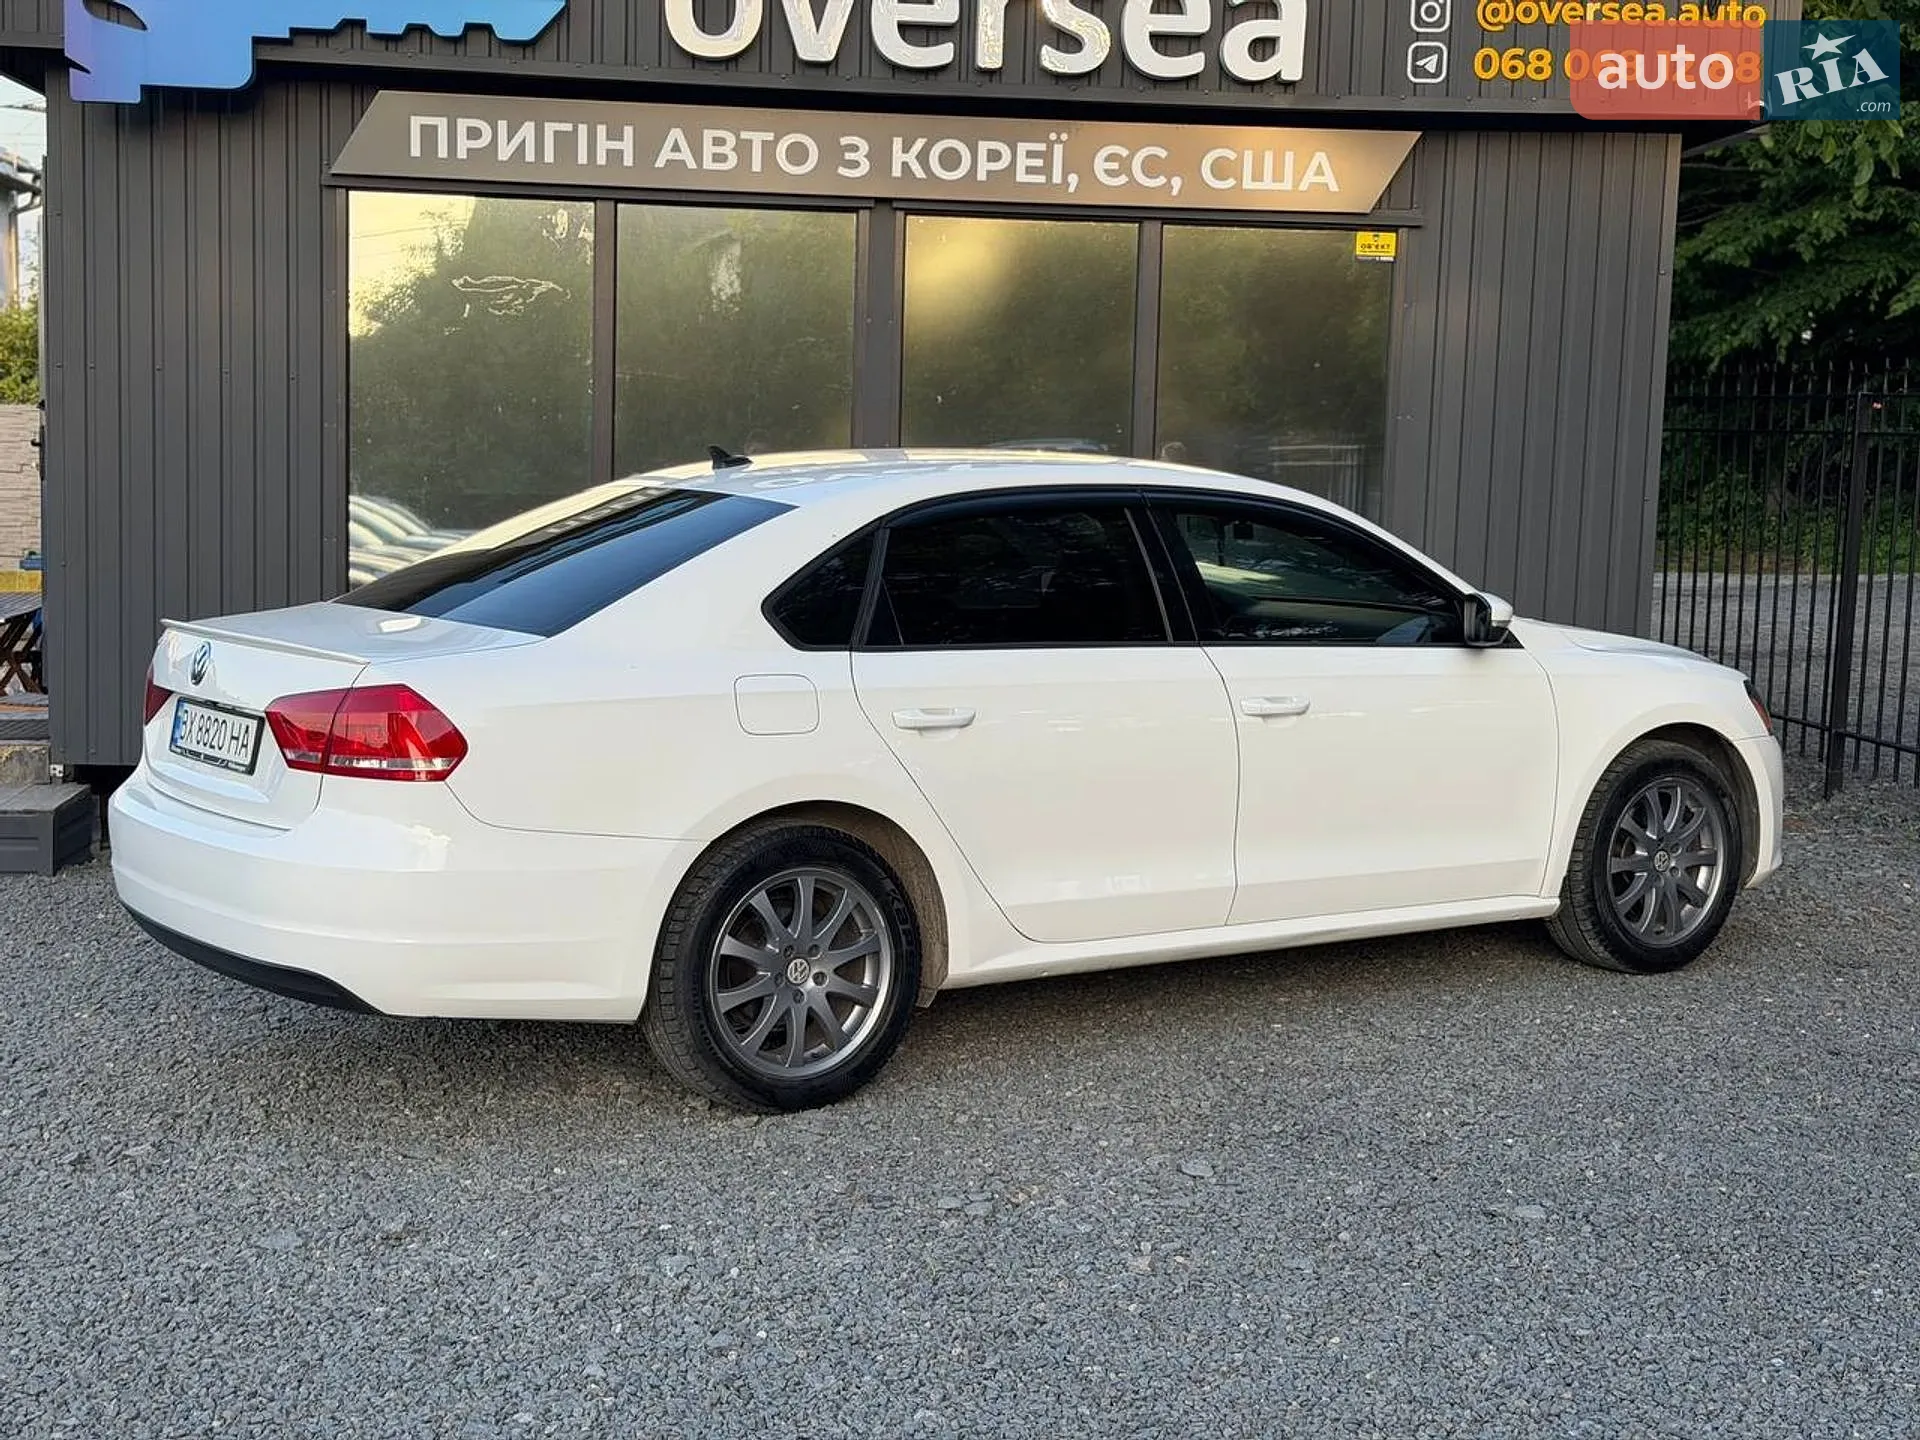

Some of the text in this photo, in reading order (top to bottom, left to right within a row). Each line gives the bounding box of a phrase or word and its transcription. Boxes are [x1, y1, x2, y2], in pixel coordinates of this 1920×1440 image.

[1475, 0, 1767, 31] @oversea.auto
[1473, 47, 1552, 81] 068
[408, 115, 1340, 196] ПРИГІН АВТО З КОРЕЇ, ЄС, США
[196, 713, 228, 751] 8820
